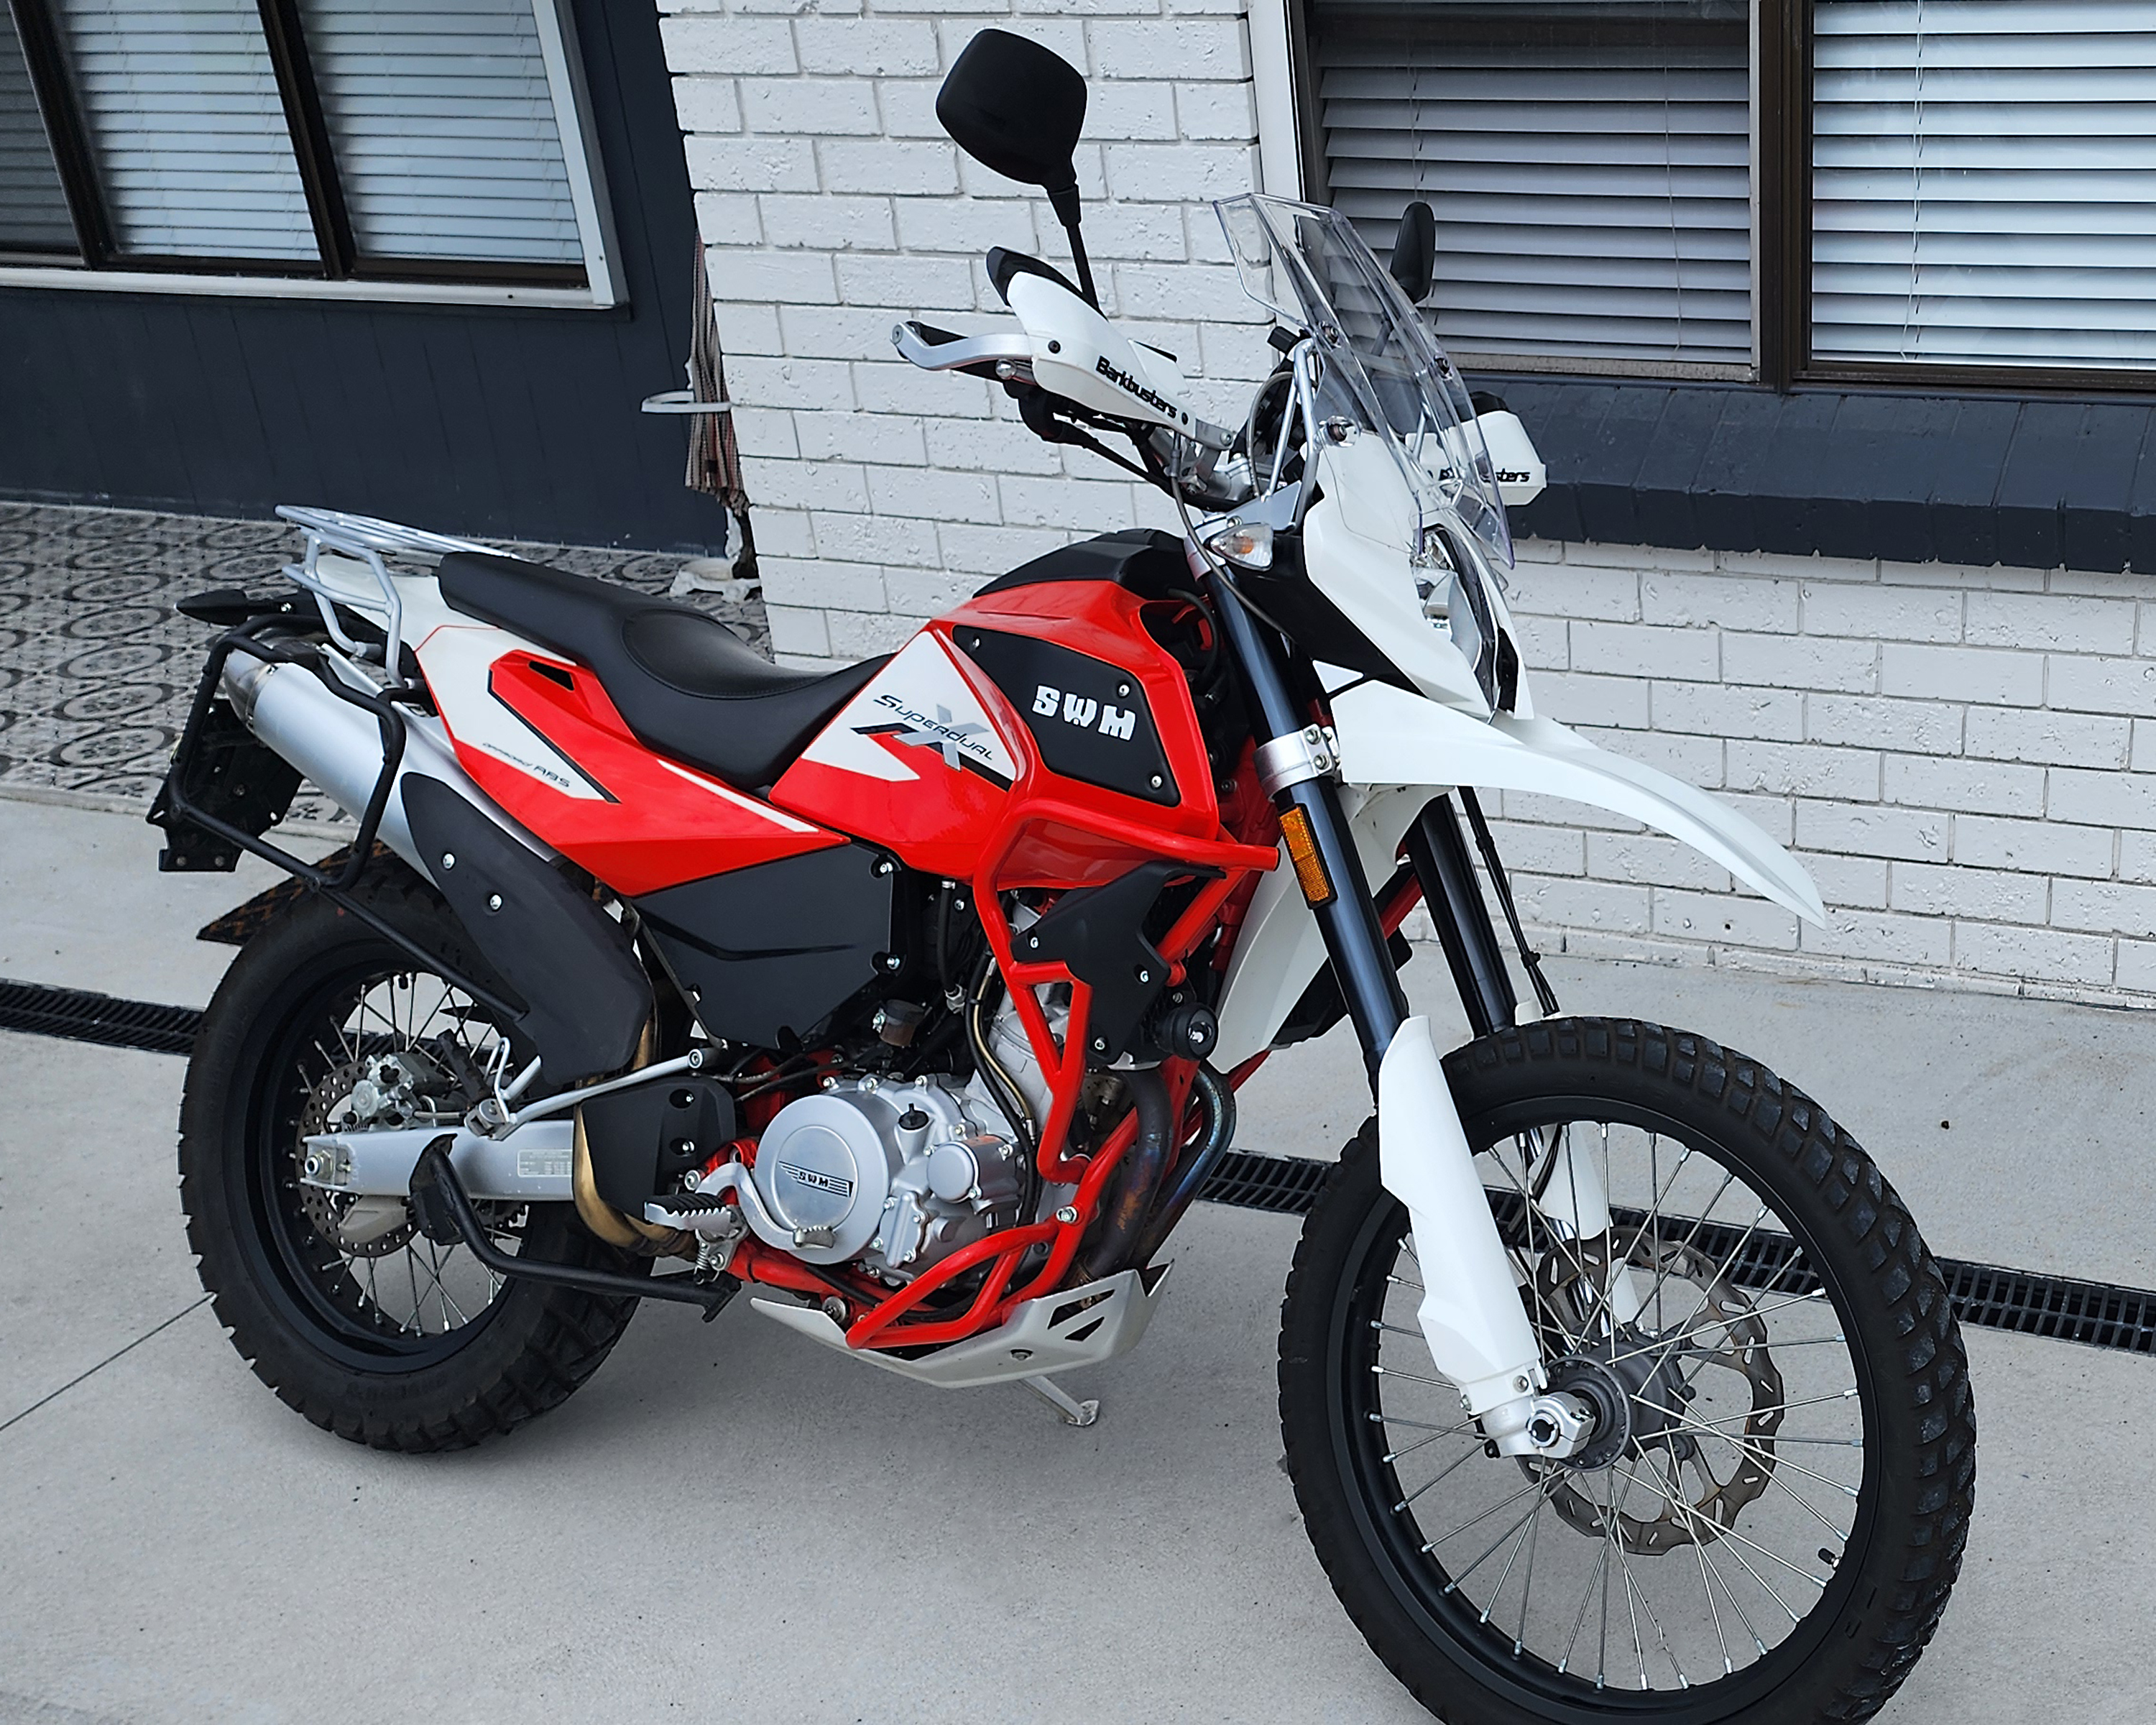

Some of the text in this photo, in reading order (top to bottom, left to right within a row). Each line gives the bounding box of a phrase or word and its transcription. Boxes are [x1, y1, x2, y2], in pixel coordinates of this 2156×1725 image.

[1095, 355, 1178, 419] Barkbusters
[1031, 684, 1137, 742] SWM
[533, 765, 571, 788] ABS
[798, 1170, 829, 1188] SWM
